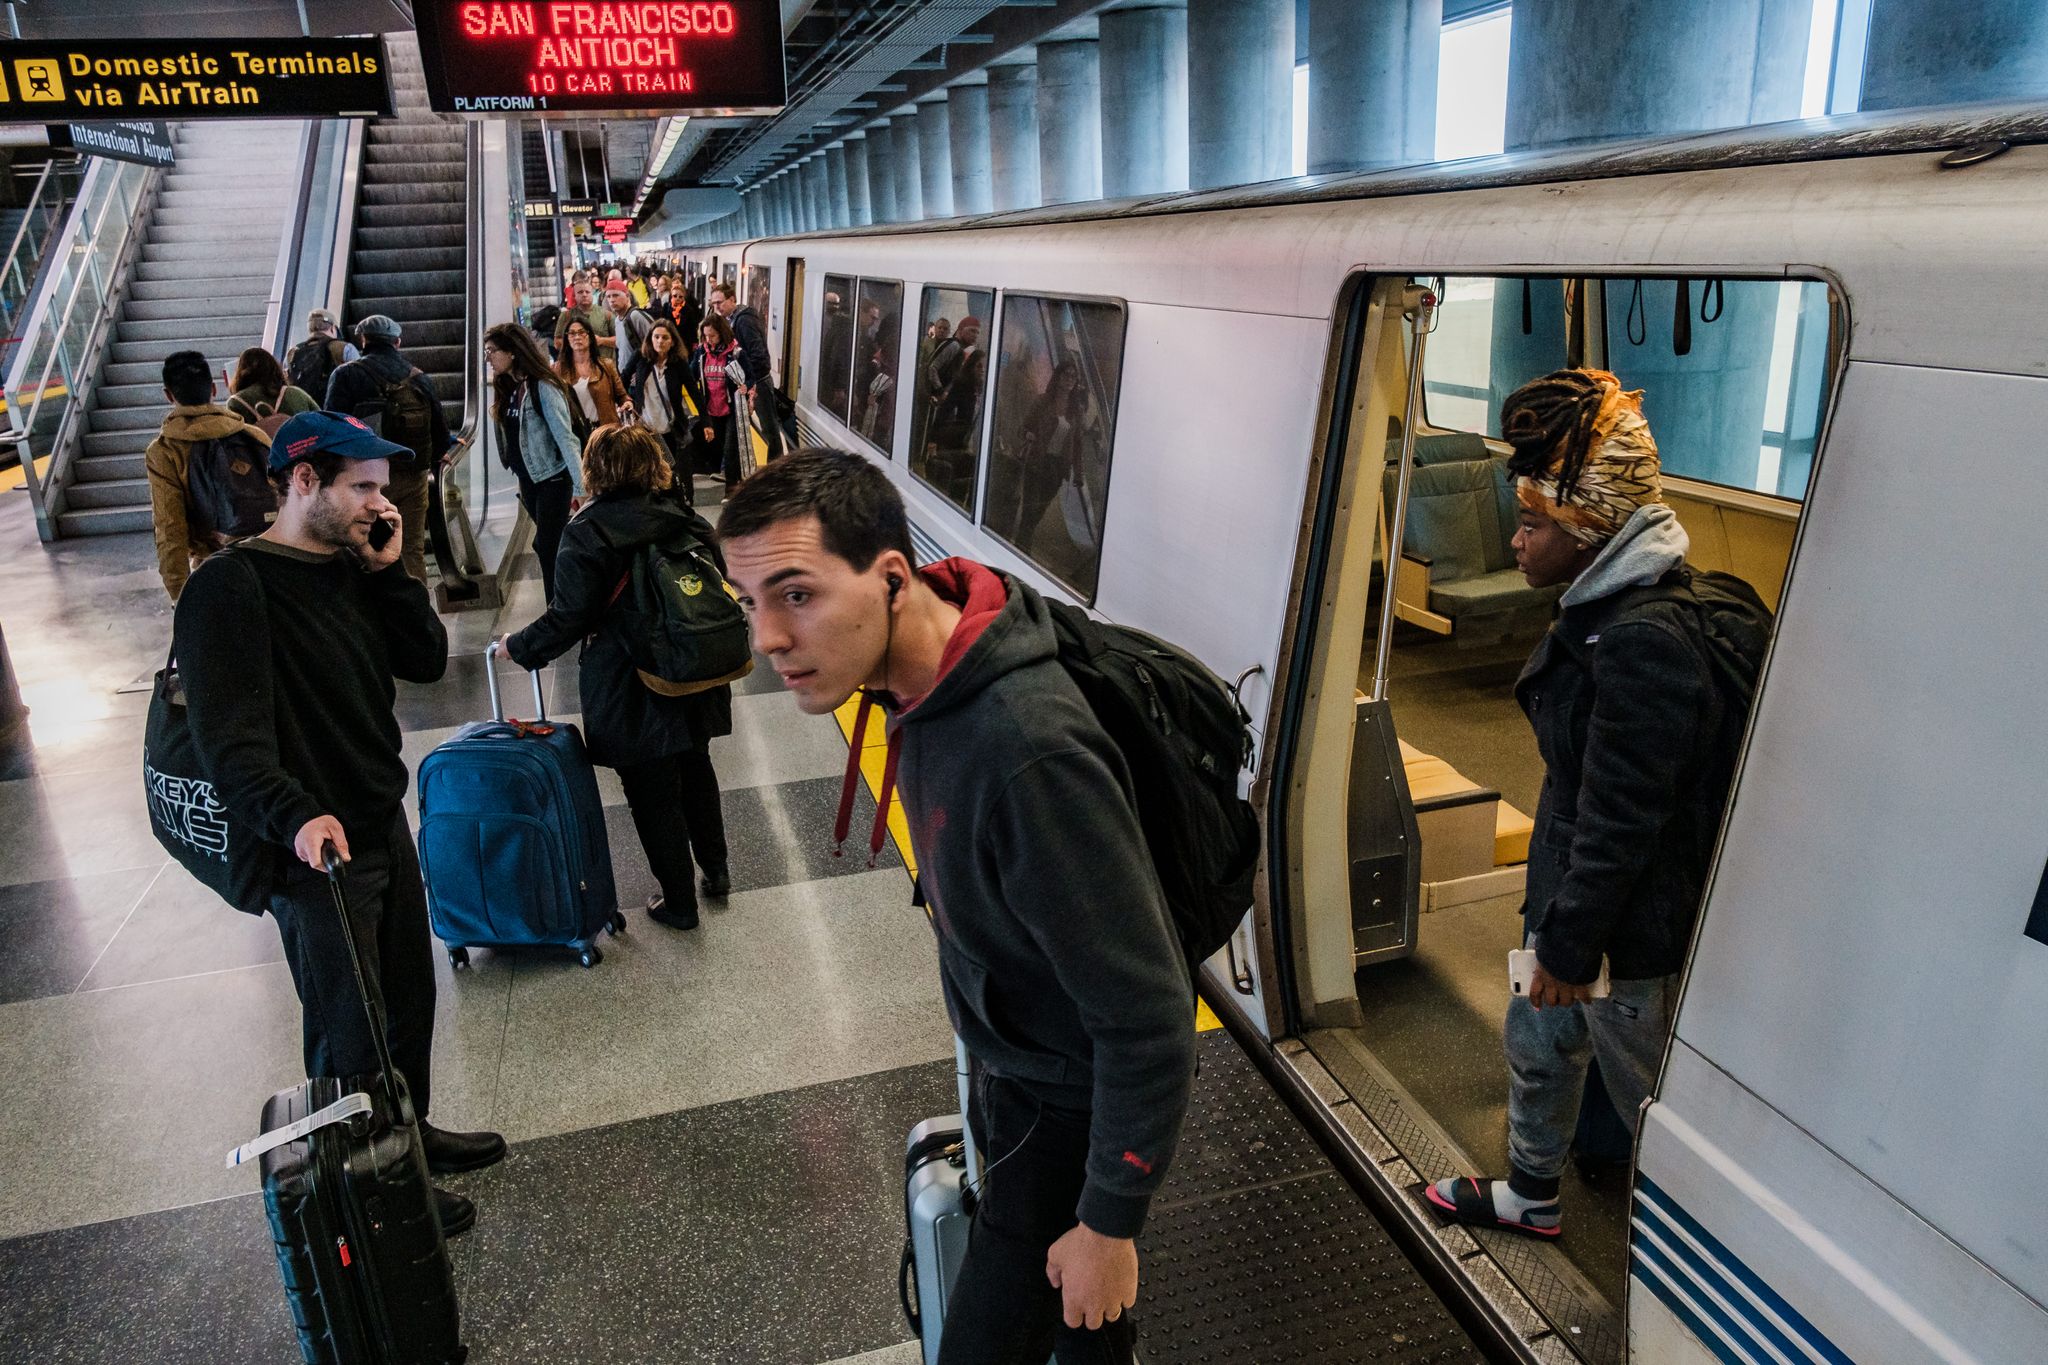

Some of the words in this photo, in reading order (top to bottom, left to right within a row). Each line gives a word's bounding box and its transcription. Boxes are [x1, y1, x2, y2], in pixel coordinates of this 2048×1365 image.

[463, 5, 534, 35] SAN
[553, 4, 735, 34] FRANCISCO
[68, 52, 219, 77] Domestic
[230, 51, 378, 75] Terminals
[538, 38, 677, 67] ANTIOCH
[75, 83, 123, 107] via
[138, 82, 259, 105] AirTrain
[529, 74, 556, 93] 10
[567, 74, 613, 92] CAR
[622, 72, 693, 91] TRAIN
[455, 96, 535, 110] PLATFORM
[540, 96, 547, 109] 1
[69, 123, 141, 155] International
[142, 136, 175, 164] Airport
[562, 205, 593, 213] Elevator
